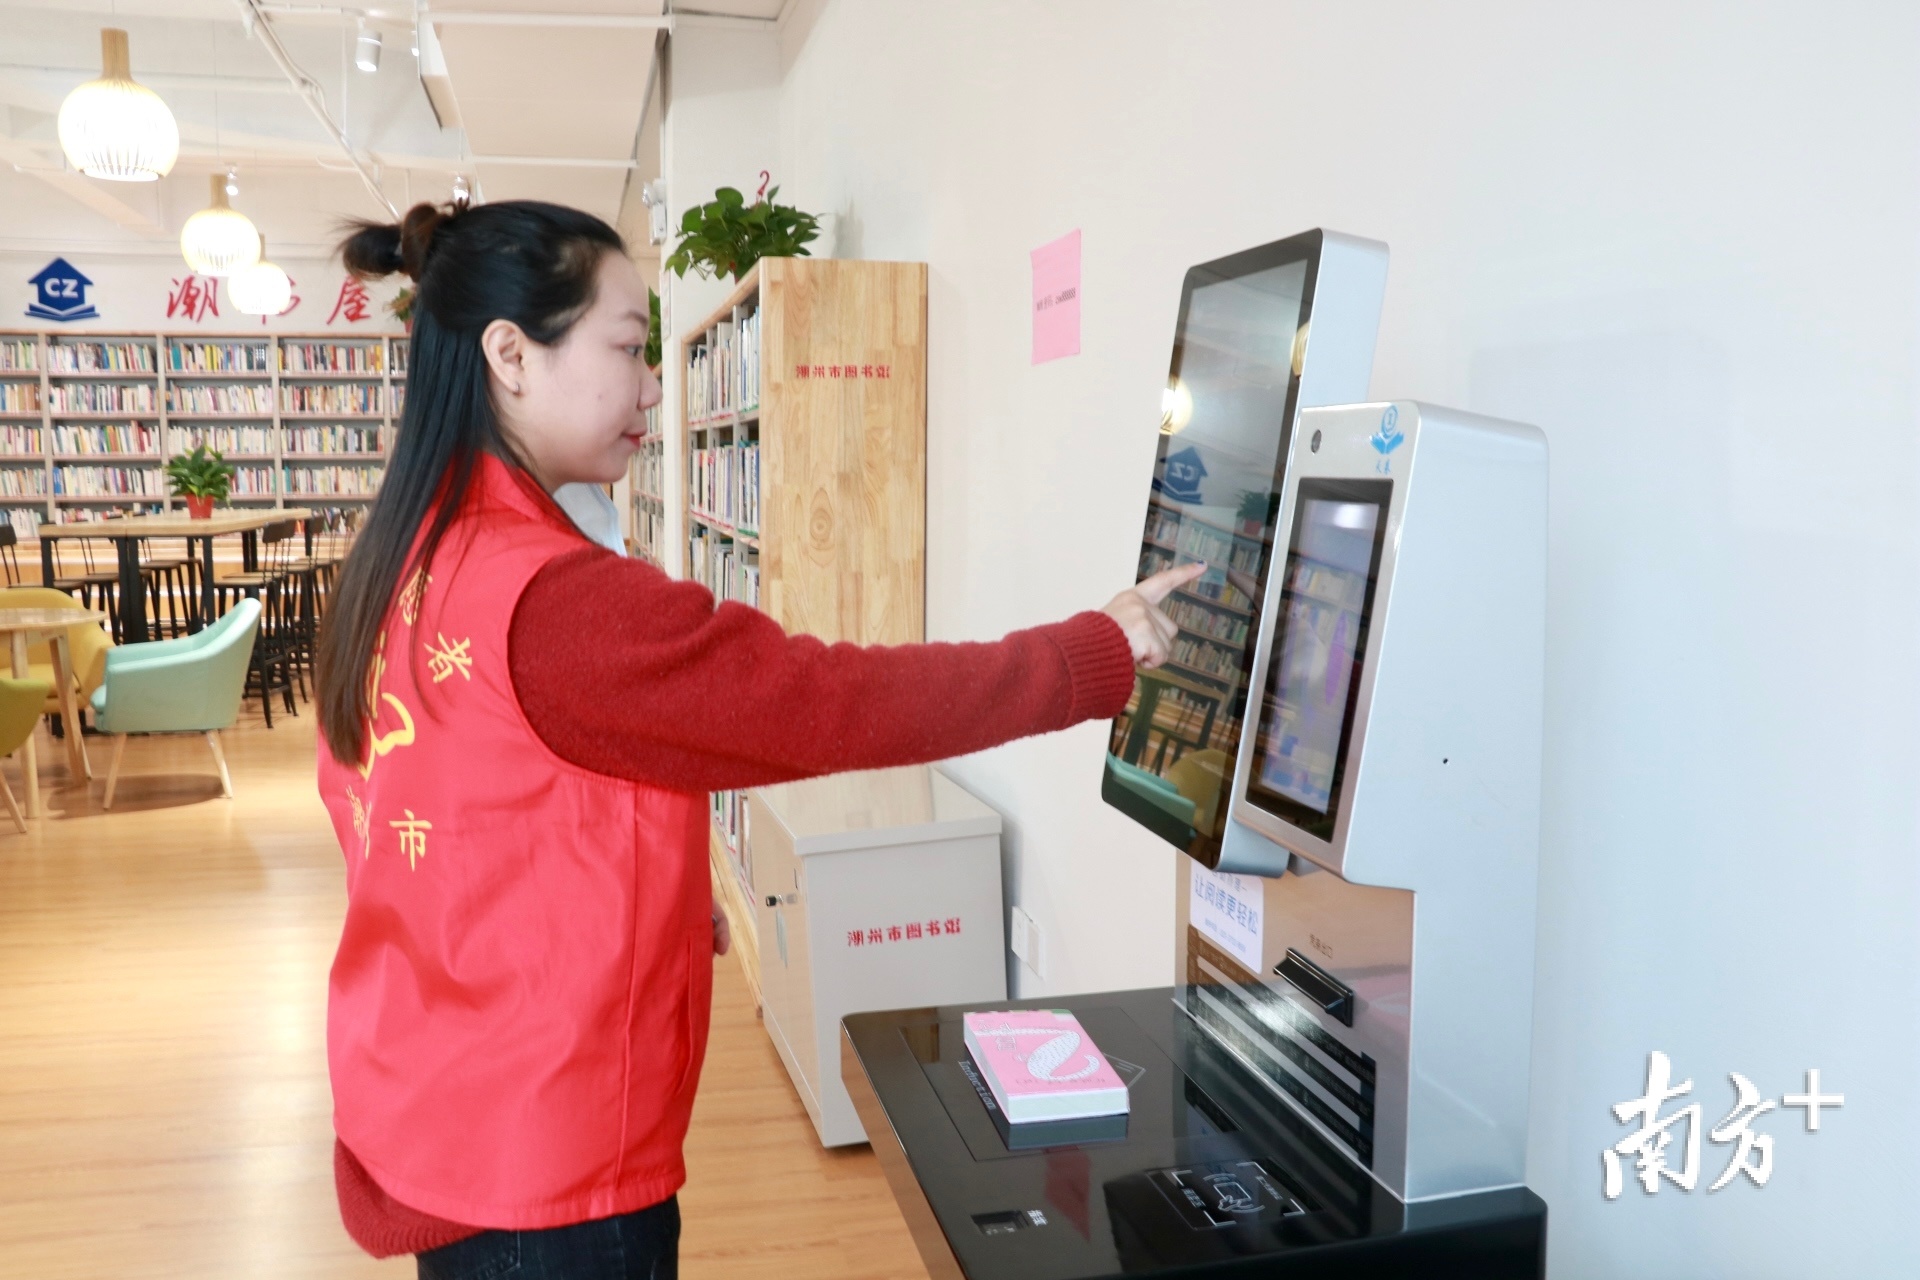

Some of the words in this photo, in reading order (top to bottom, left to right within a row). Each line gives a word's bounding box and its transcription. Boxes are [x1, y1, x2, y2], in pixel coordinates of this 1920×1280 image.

[44, 278, 79, 298] CZ
[796, 365, 890, 379] 潮州市图书馆
[1195, 873, 1258, 936] 让阅读更轻松
[848, 917, 961, 947] 潮州市图书馆
